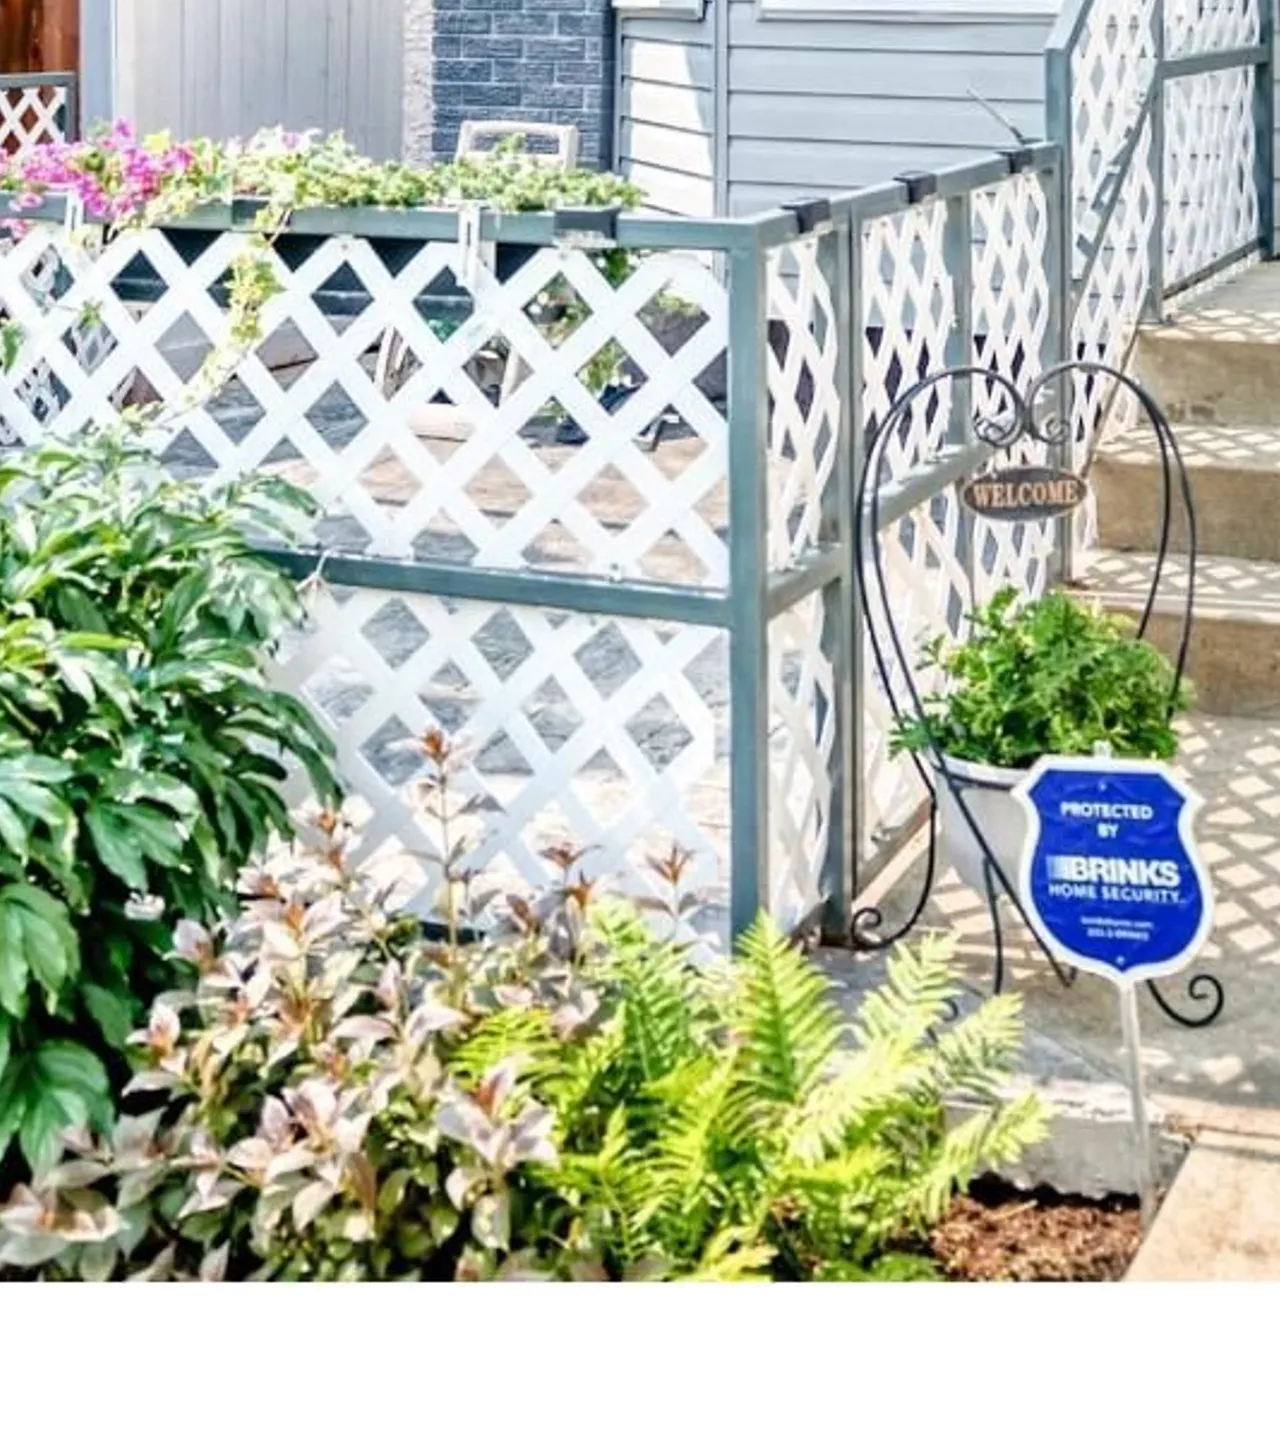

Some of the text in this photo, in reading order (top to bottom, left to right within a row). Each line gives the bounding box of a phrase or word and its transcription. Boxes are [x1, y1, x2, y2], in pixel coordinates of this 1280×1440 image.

[973, 479, 1079, 510] WELCOME
[1060, 801, 1154, 820] PROTECTED
[1096, 822, 1119, 839] BY
[1070, 855, 1181, 887] BRINKS
[1048, 883, 1097, 899] HOME
